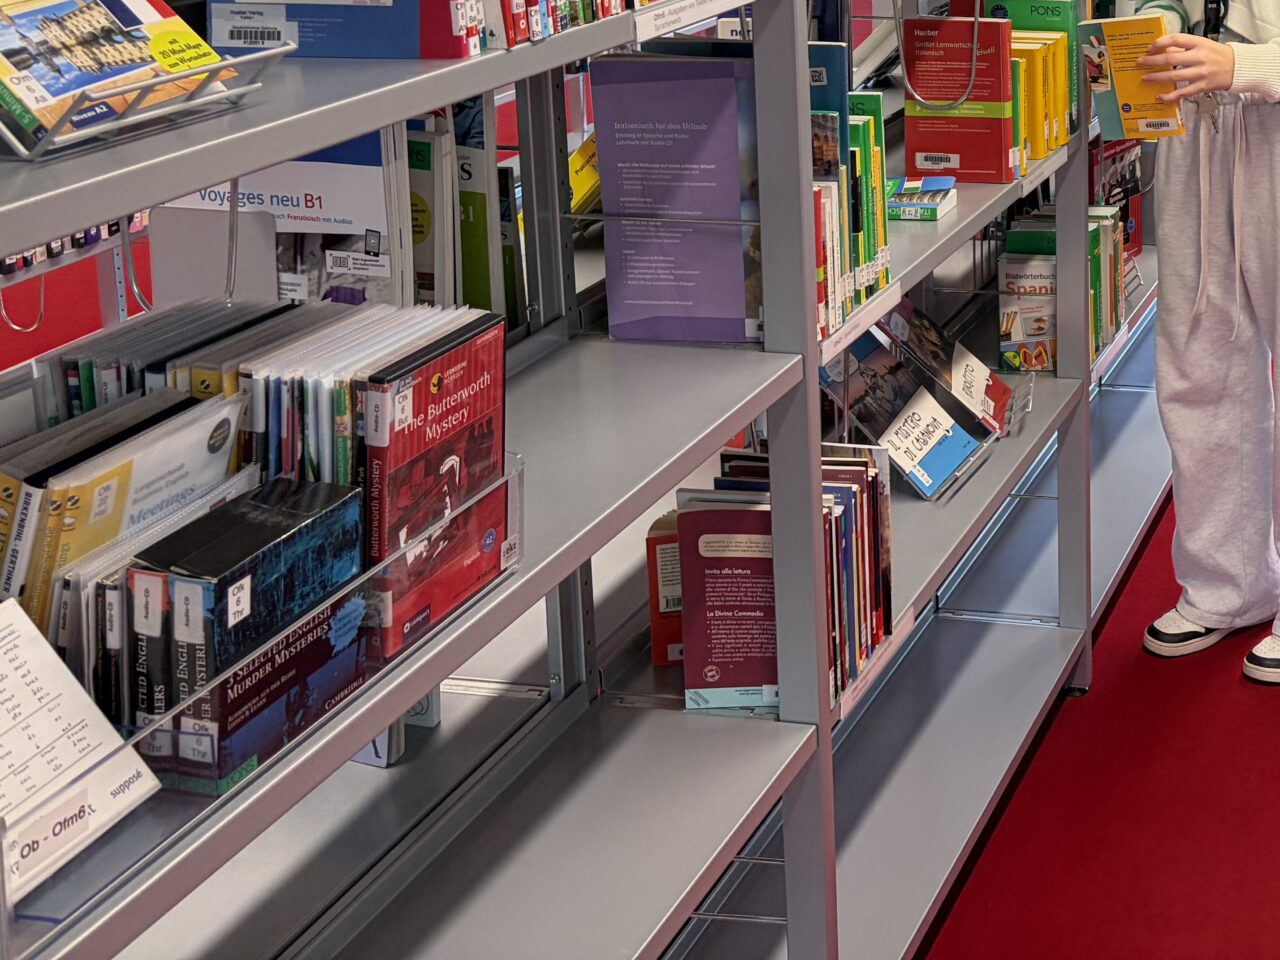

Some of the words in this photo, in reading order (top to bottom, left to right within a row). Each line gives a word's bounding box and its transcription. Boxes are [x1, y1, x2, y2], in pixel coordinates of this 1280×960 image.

[1030, 5, 1061, 16] PONS
[914, 29, 939, 37] Hueber
[915, 41, 935, 49] Großer
[936, 41, 980, 49] Lernwortschtz
[71, 109, 95, 122] Niveau
[94, 104, 109, 116] A2
[614, 122, 654, 130] Italienisch
[655, 122, 667, 130] für
[667, 122, 681, 130] den
[199, 189, 266, 208] Voyges
[270, 195, 300, 208] neu
[304, 193, 324, 210] B1
[287, 213, 322, 223] Französisch
[333, 217, 353, 225] Audios
[1005, 272, 1057, 281] Bildwörterbuch
[1005, 281, 1057, 300] Spani
[427, 371, 491, 420] Butterworth
[426, 405, 470, 443] Mystery
[894, 412, 922, 444] MISTERO
[904, 449, 916, 462] DI
[913, 416, 944, 451] CASANOVA
[371, 458, 382, 496] Mystery
[15, 491, 33, 544] BIRKENBIHL
[126, 486, 195, 529] Meetings
[370, 497, 381, 557] Butterworth
[1, 548, 20, 593] GERTHNER
[235, 596, 242, 606] 6
[135, 635, 148, 673] ENGLI
[235, 639, 287, 681] SELECTED
[288, 604, 332, 642] ENGLISH
[227, 663, 273, 704] MURDER
[273, 621, 330, 665] MYSTERIES
[324, 677, 365, 711] CAMBRIDGE
[110, 769, 143, 799] supposé
[20, 839, 40, 860] Ob
